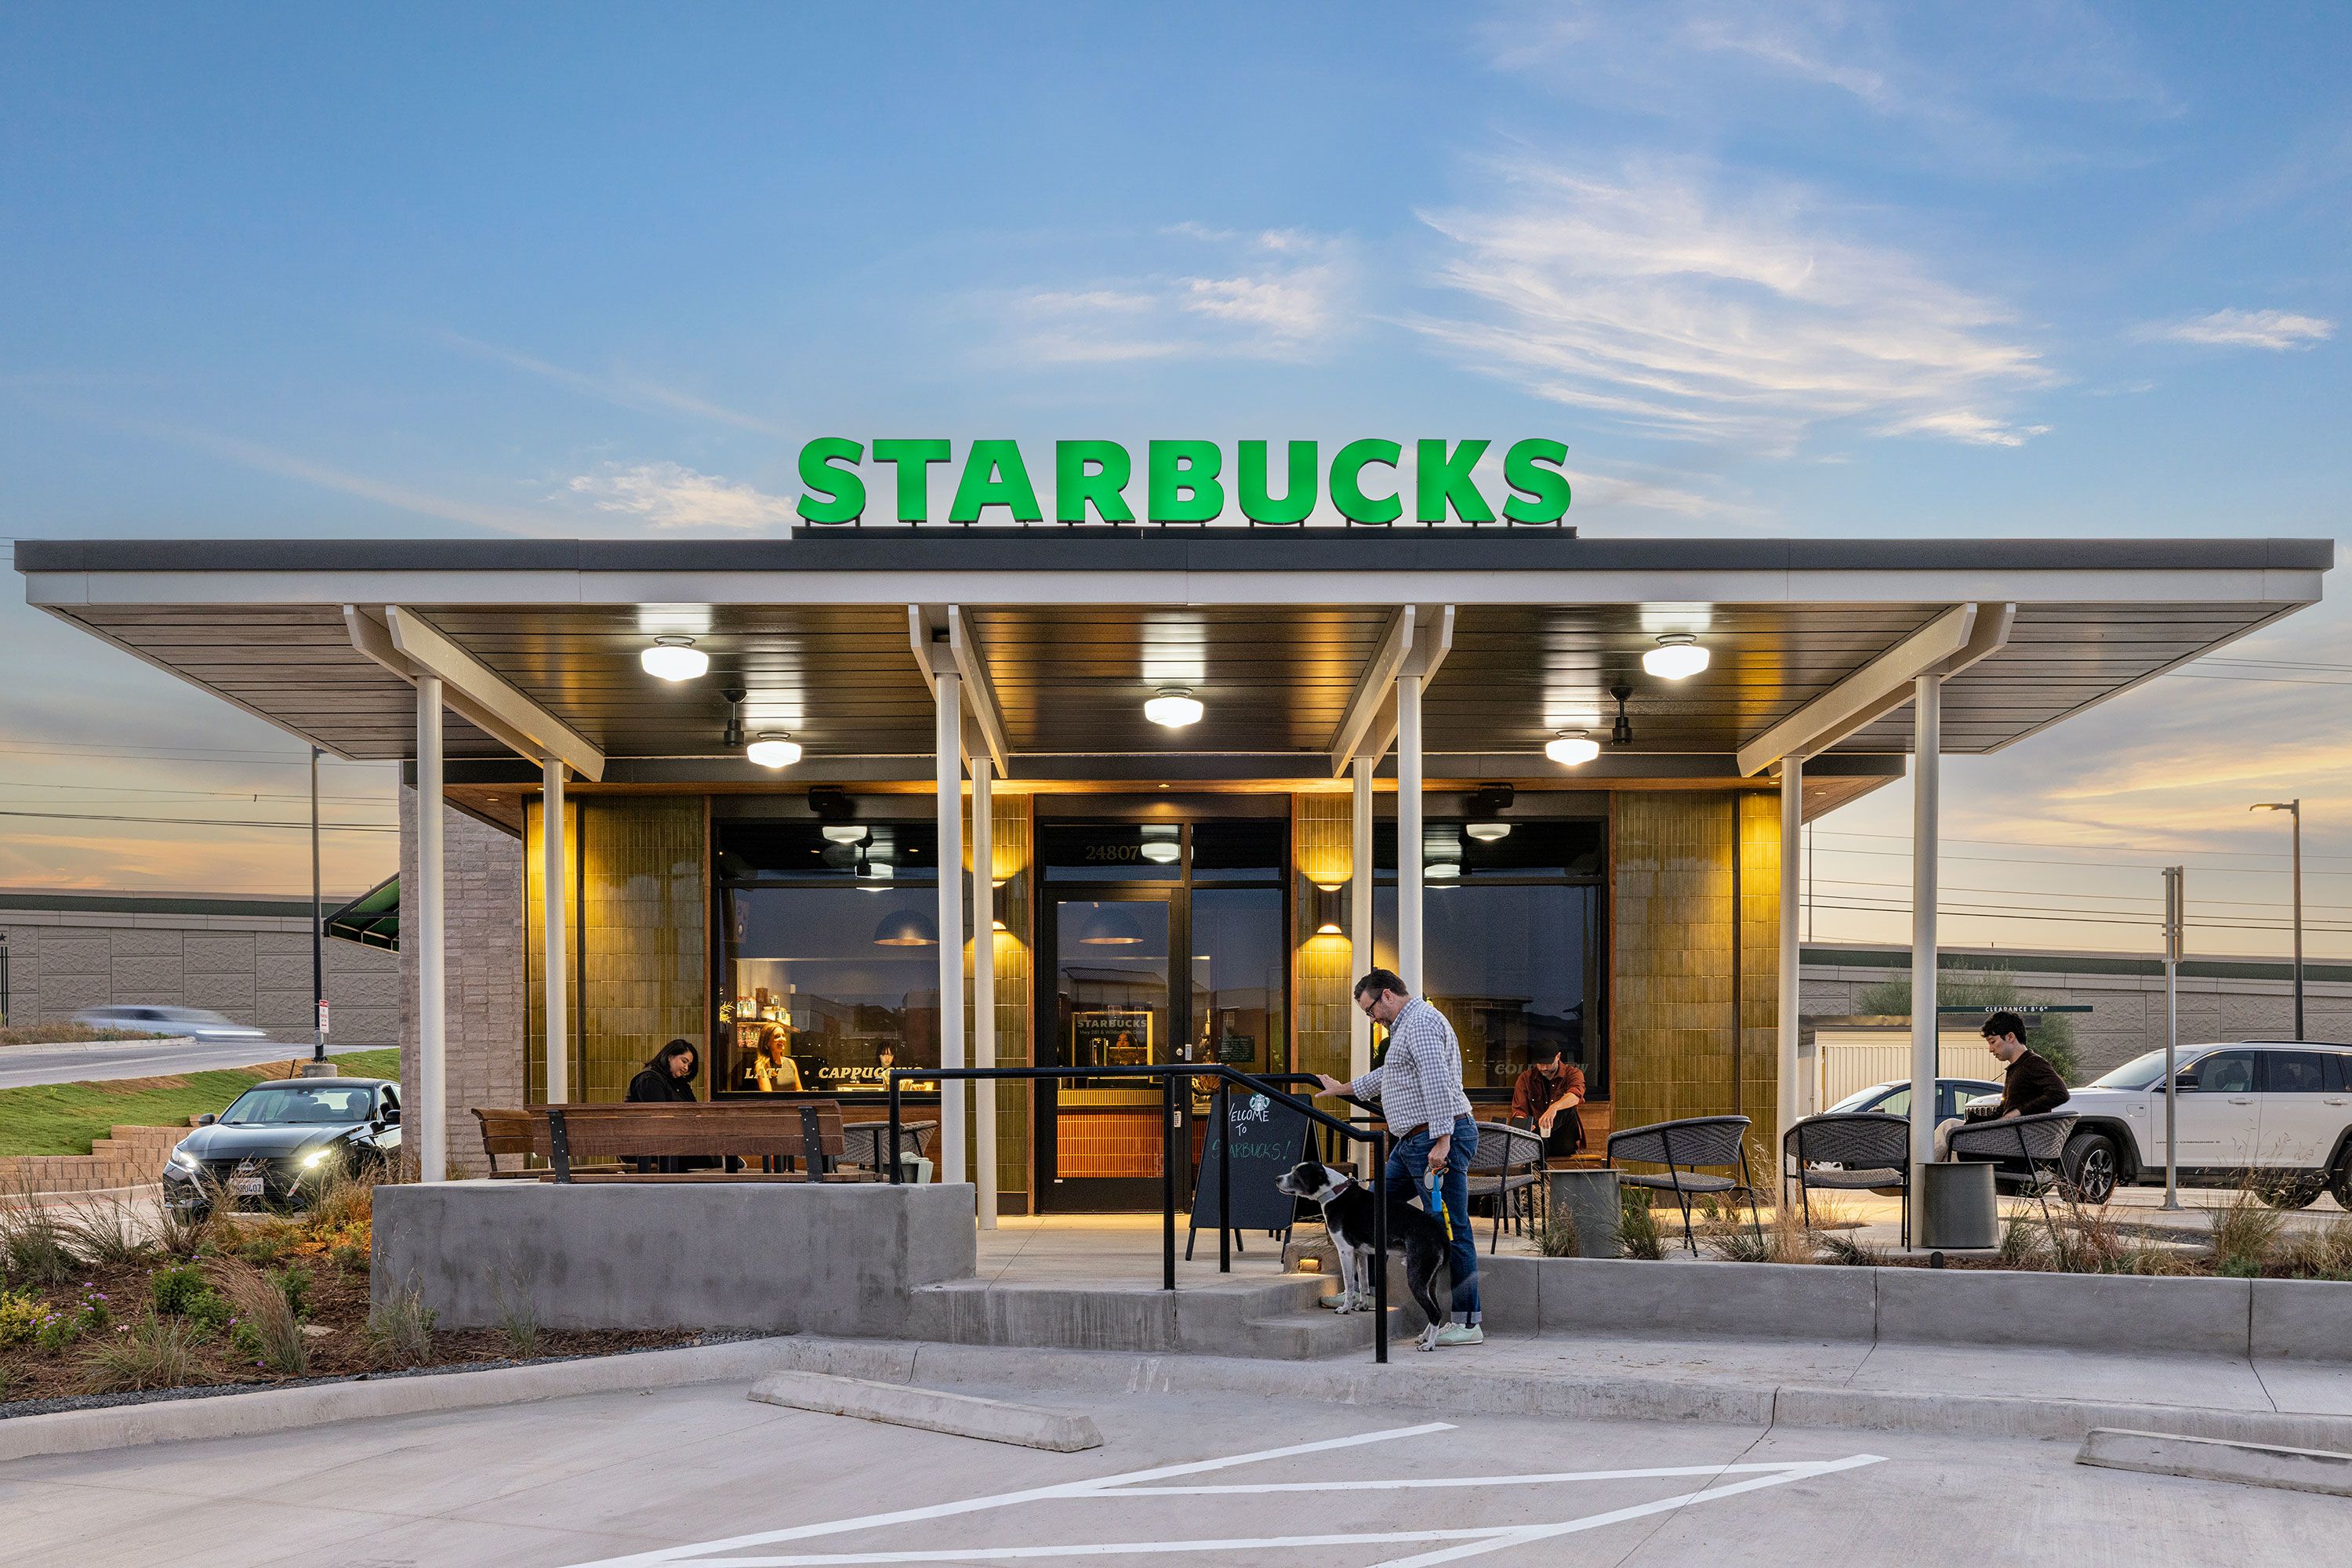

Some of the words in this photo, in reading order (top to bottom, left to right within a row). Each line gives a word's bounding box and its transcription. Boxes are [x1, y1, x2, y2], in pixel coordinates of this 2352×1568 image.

[797, 437, 1571, 526] STARBUCKS
[1085, 845, 1139, 860] 24807
[1077, 1019, 1147, 1028] STARBUCKS
[1211, 1138, 1291, 1161] SARBUCKS!
